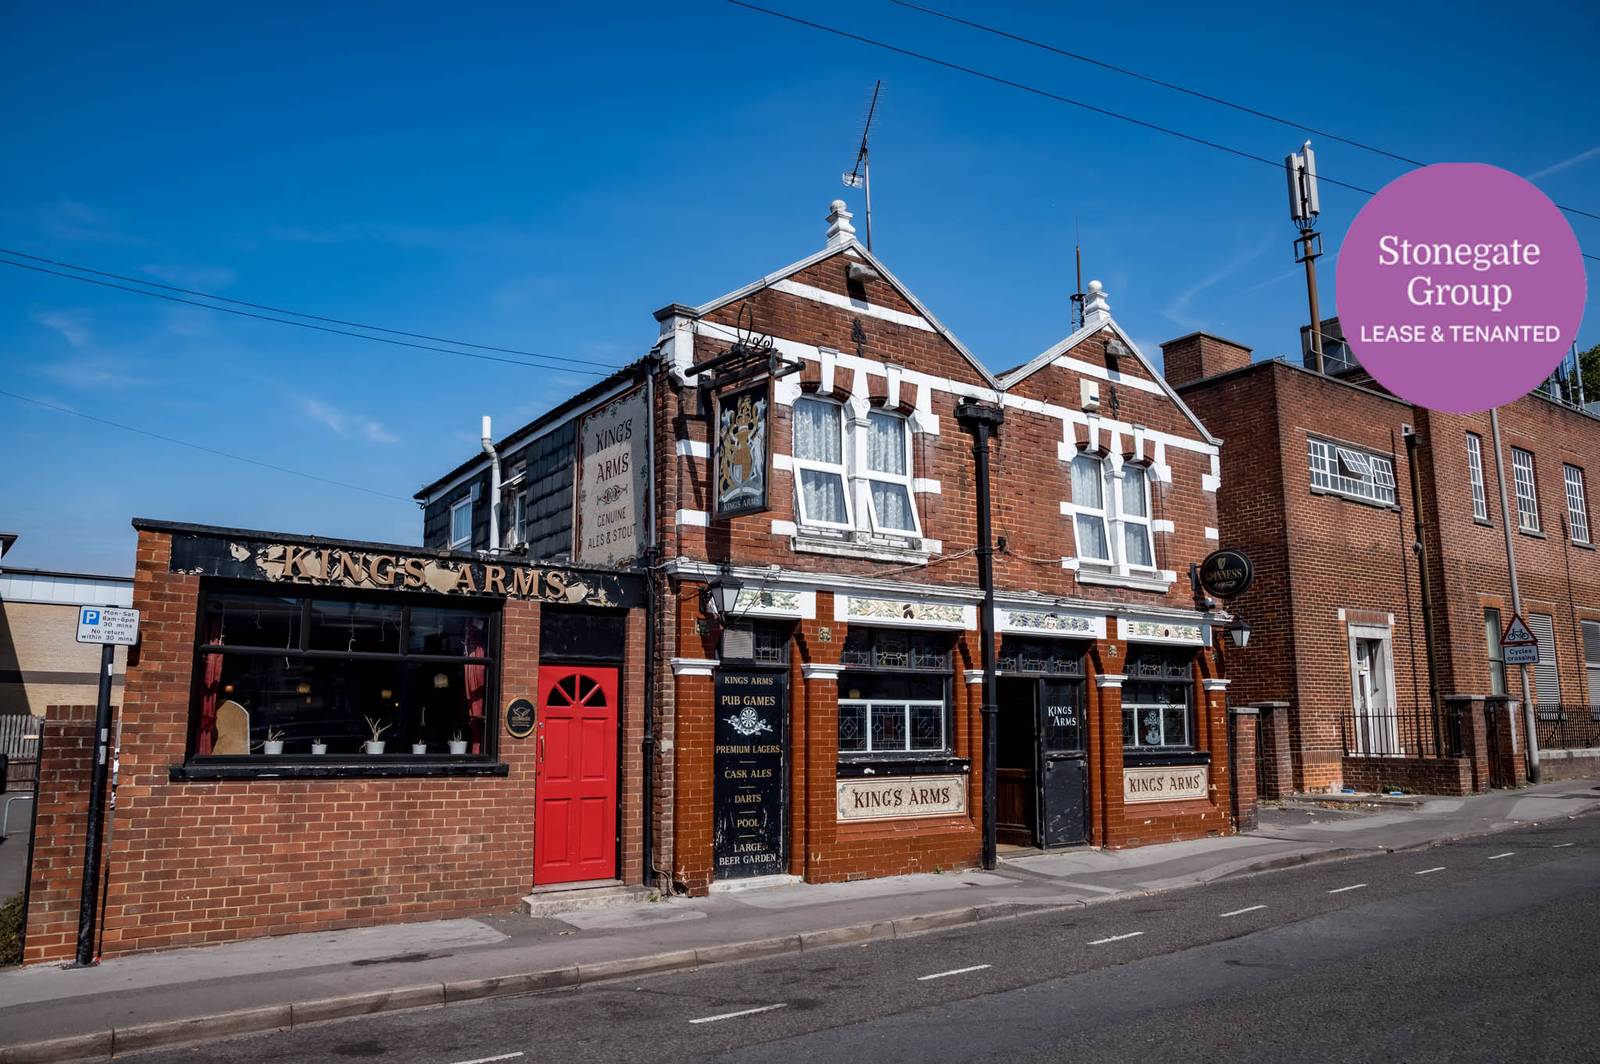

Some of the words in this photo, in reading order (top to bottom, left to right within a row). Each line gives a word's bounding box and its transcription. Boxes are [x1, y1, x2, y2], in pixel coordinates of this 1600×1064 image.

[596, 452, 629, 484] ARMS
[597, 507, 626, 528] GENUINE
[588, 533, 604, 549] ALES
[606, 531, 611, 544] &
[612, 523, 637, 543] STOUT
[282, 546, 426, 587] KINGS
[453, 563, 566, 599] ARMS
[85, 611, 97, 623] P
[724, 676, 748, 684] KINGS
[751, 677, 774, 685] ARMS
[722, 695, 740, 705] PUB
[743, 696, 776, 705] GAMES
[1048, 706, 1072, 717] KINGS
[1053, 716, 1077, 726] ARMS
[716, 745, 750, 753] PREMIUM
[752, 745, 780, 753] LAGERS
[724, 769, 747, 778] CASK
[751, 769, 772, 778] ALES
[1129, 776, 1164, 792] KINGS
[1169, 774, 1200, 790] ARMS
[734, 794, 762, 803] DARTS
[853, 788, 902, 808] KINGS
[909, 786, 950, 805] ARMS
[737, 818, 760, 828] POOL
[734, 843, 763, 852] LARGE
[720, 856, 740, 865] BEER
[743, 853, 776, 863] GARDEN
